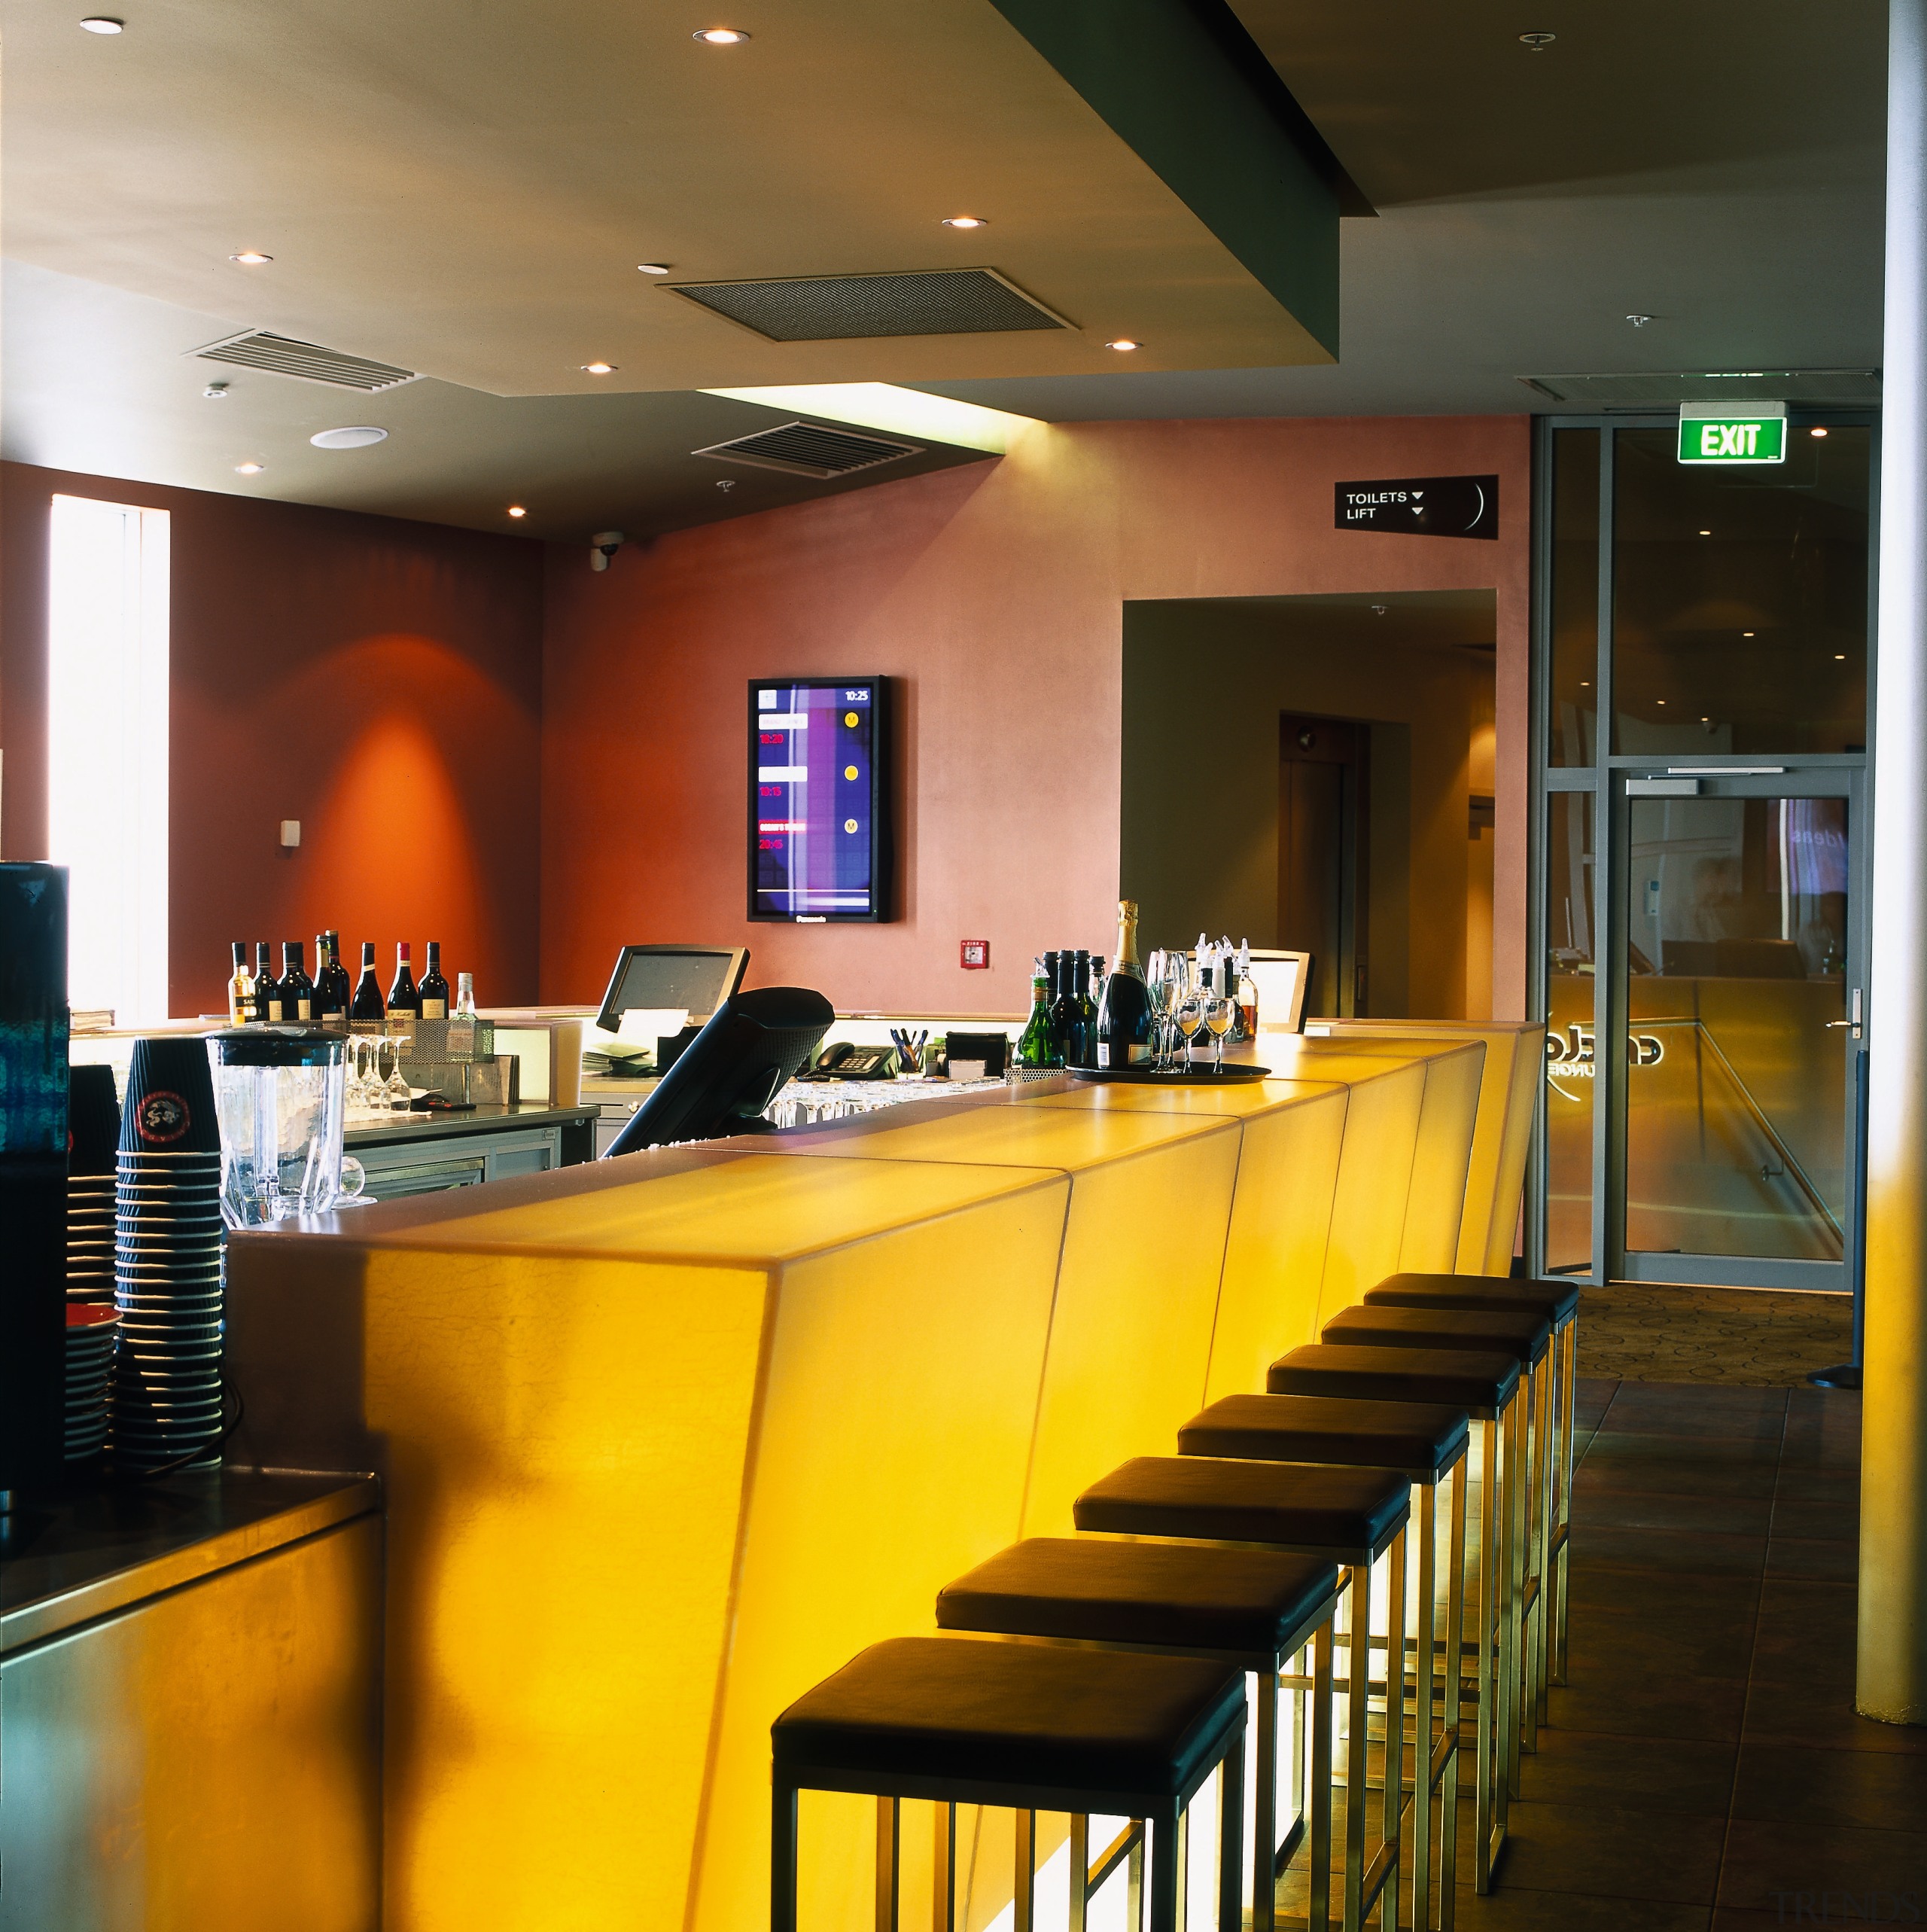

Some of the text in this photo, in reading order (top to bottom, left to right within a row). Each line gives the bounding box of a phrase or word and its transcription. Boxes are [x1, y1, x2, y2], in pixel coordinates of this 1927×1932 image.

[1700, 424, 1761, 456] EXIT
[1347, 492, 1407, 504] TOILETS
[1347, 507, 1376, 520] LIFT
[845, 690, 868, 701] 10:25
